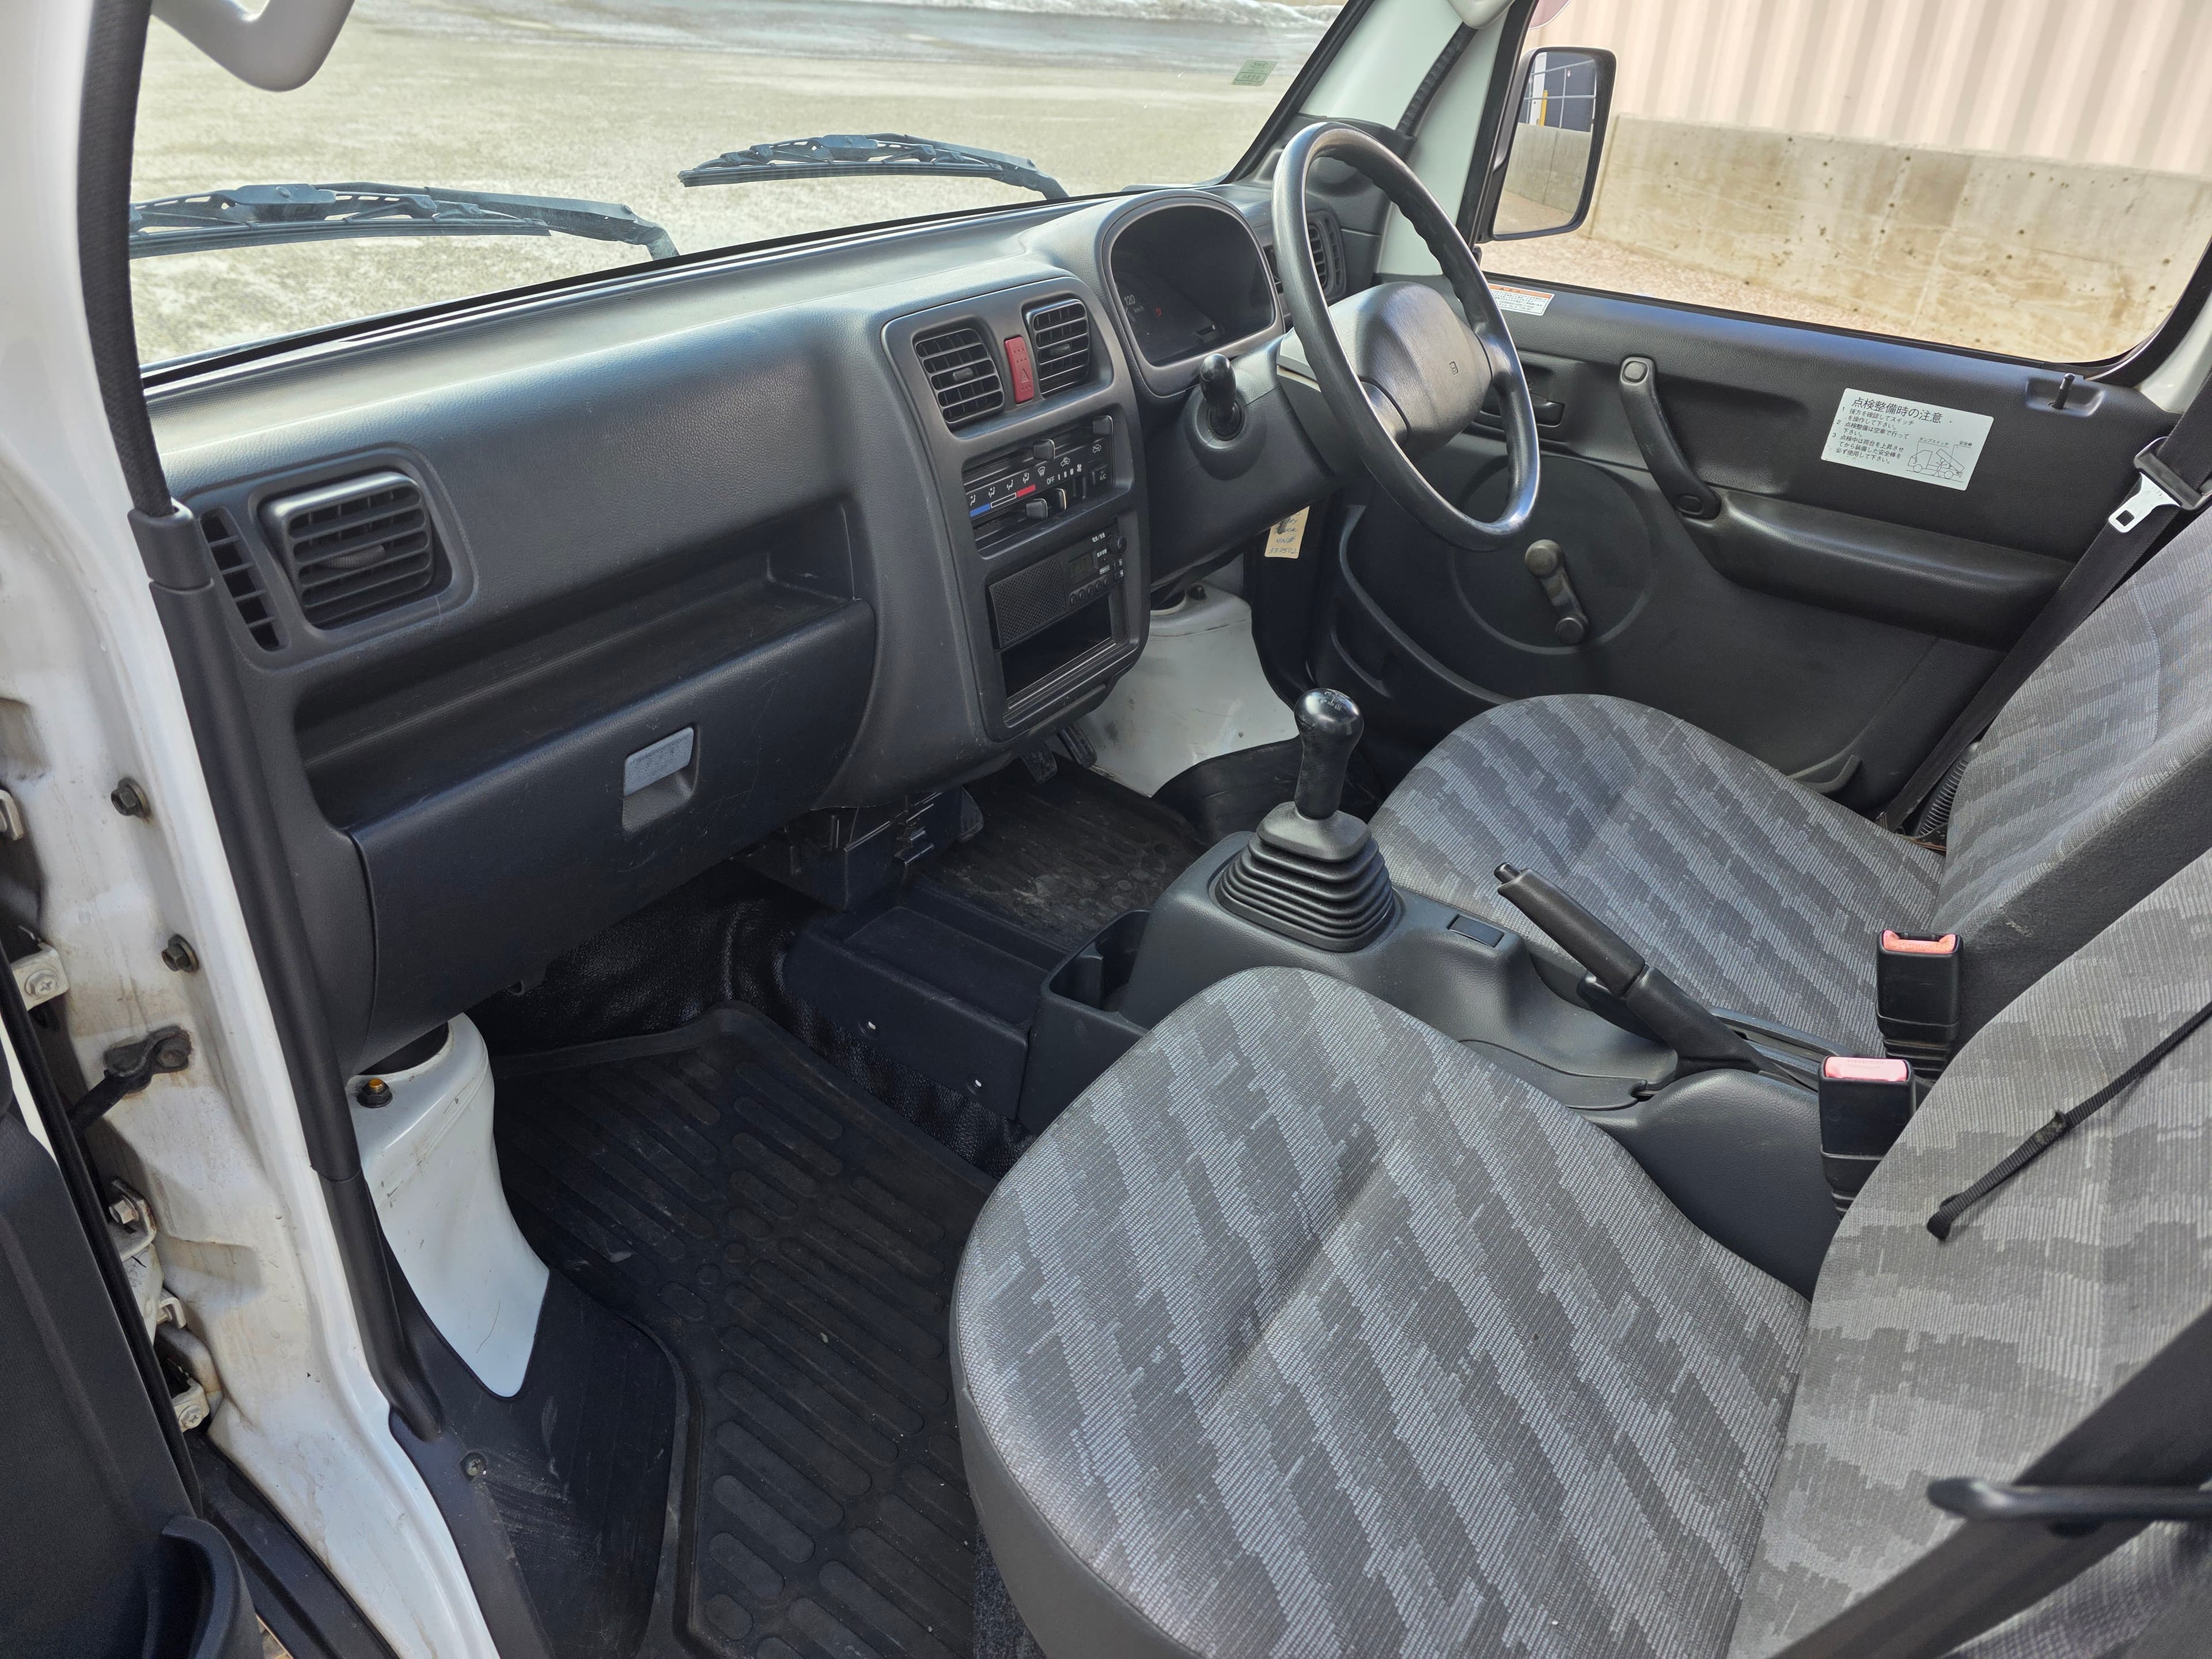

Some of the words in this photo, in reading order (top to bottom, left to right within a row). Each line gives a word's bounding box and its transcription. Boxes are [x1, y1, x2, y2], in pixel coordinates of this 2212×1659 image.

[1124, 294, 1135, 305] 120
[1851, 397, 1943, 423] 点検整備時の注意
[1843, 428, 1862, 437] 下さい。
[1844, 422, 1910, 439] 点検整備は空車で行って
[1046, 476, 1055, 485] OFF
